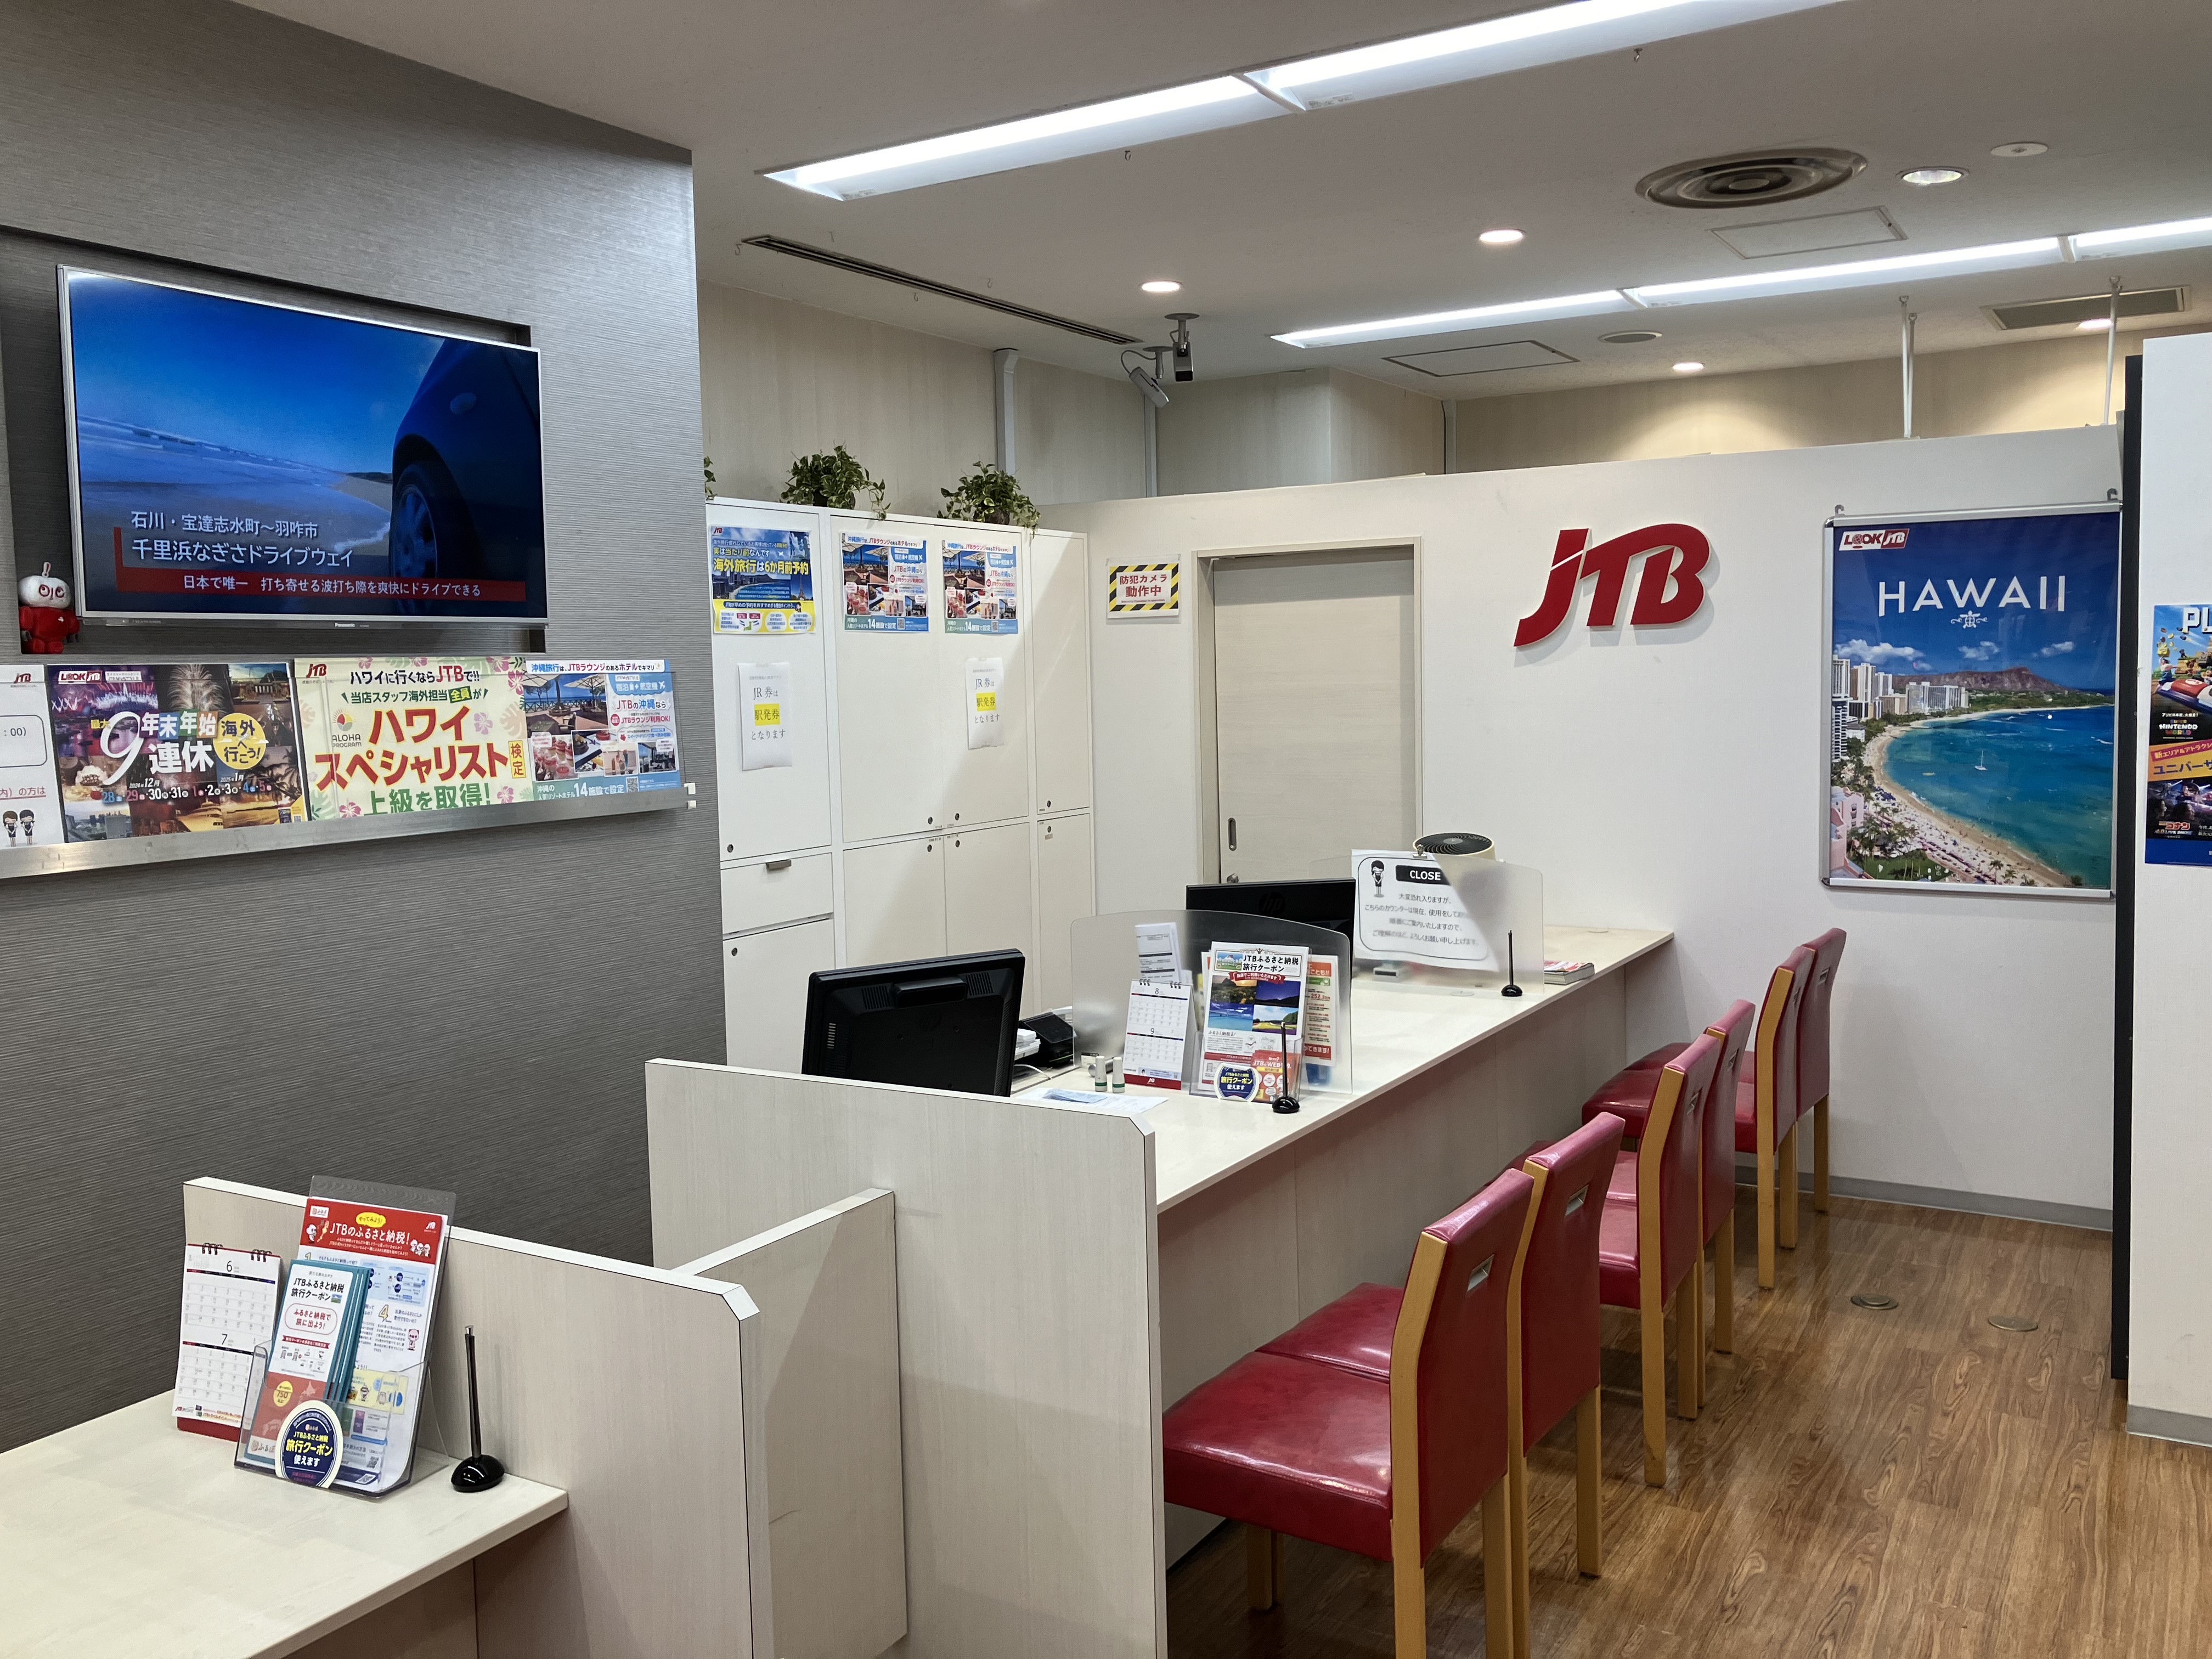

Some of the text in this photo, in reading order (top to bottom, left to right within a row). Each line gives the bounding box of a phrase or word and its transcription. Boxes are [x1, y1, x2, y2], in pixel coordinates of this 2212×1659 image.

[1844, 532, 1905, 548] LOOK JTB
[132, 538, 353, 568] 千里浜なぎさドライブウェイ
[184, 574, 481, 597] 日本で唯一 打ち寄せる波打ち際を爽快にドライブできる
[1120, 574, 1167, 585] 防犯カメラ
[1514, 523, 1710, 647] JTB
[1125, 585, 1161, 597] 動作中
[1878, 574, 2066, 617] HAWAII
[61, 673, 101, 682] LOOK JTB
[306, 664, 327, 678] JTB
[350, 665, 480, 686] ハワイに行くならJTBで!!
[14, 673, 31, 684] JTB
[351, 686, 482, 704] 当店スタッフ海外担当全員が
[617, 698, 667, 710] JTBの沖縄なら
[754, 708, 780, 721] 駅発券
[974, 714, 1000, 724] となります
[141, 710, 216, 738] 年末年始
[221, 719, 256, 737] 海外
[369, 706, 470, 745] ハワイ
[332, 733, 361, 742] ALOHA
[751, 729, 786, 740] となります
[148, 740, 215, 775] 連休
[511, 742, 525, 776] 検定
[314, 742, 509, 792] スペシャリスト
[2165, 821, 2190, 830] コナン
[1409, 870, 1441, 881] CLOSE
[1243, 955, 1299, 966] JTBふるさと納税
[1243, 963, 1285, 973] 旅行クーポン
[1221, 1076, 1253, 1085] 旅行クーポン
[330, 1223, 411, 1245] JTBのふるさと納税!
[226, 1260, 233, 1272] 6
[293, 1278, 345, 1293] JTBふるさと納税
[291, 1287, 331, 1301] 旅行クーポン
[294, 1308, 331, 1321] ふるさと納税で
[378, 1304, 389, 1322] 4
[296, 1318, 326, 1330] 旅に出よう!
[221, 1333, 228, 1345] 7
[285, 1438, 333, 1457] 旅行クーポン
[294, 1454, 320, 1468] 使えます
